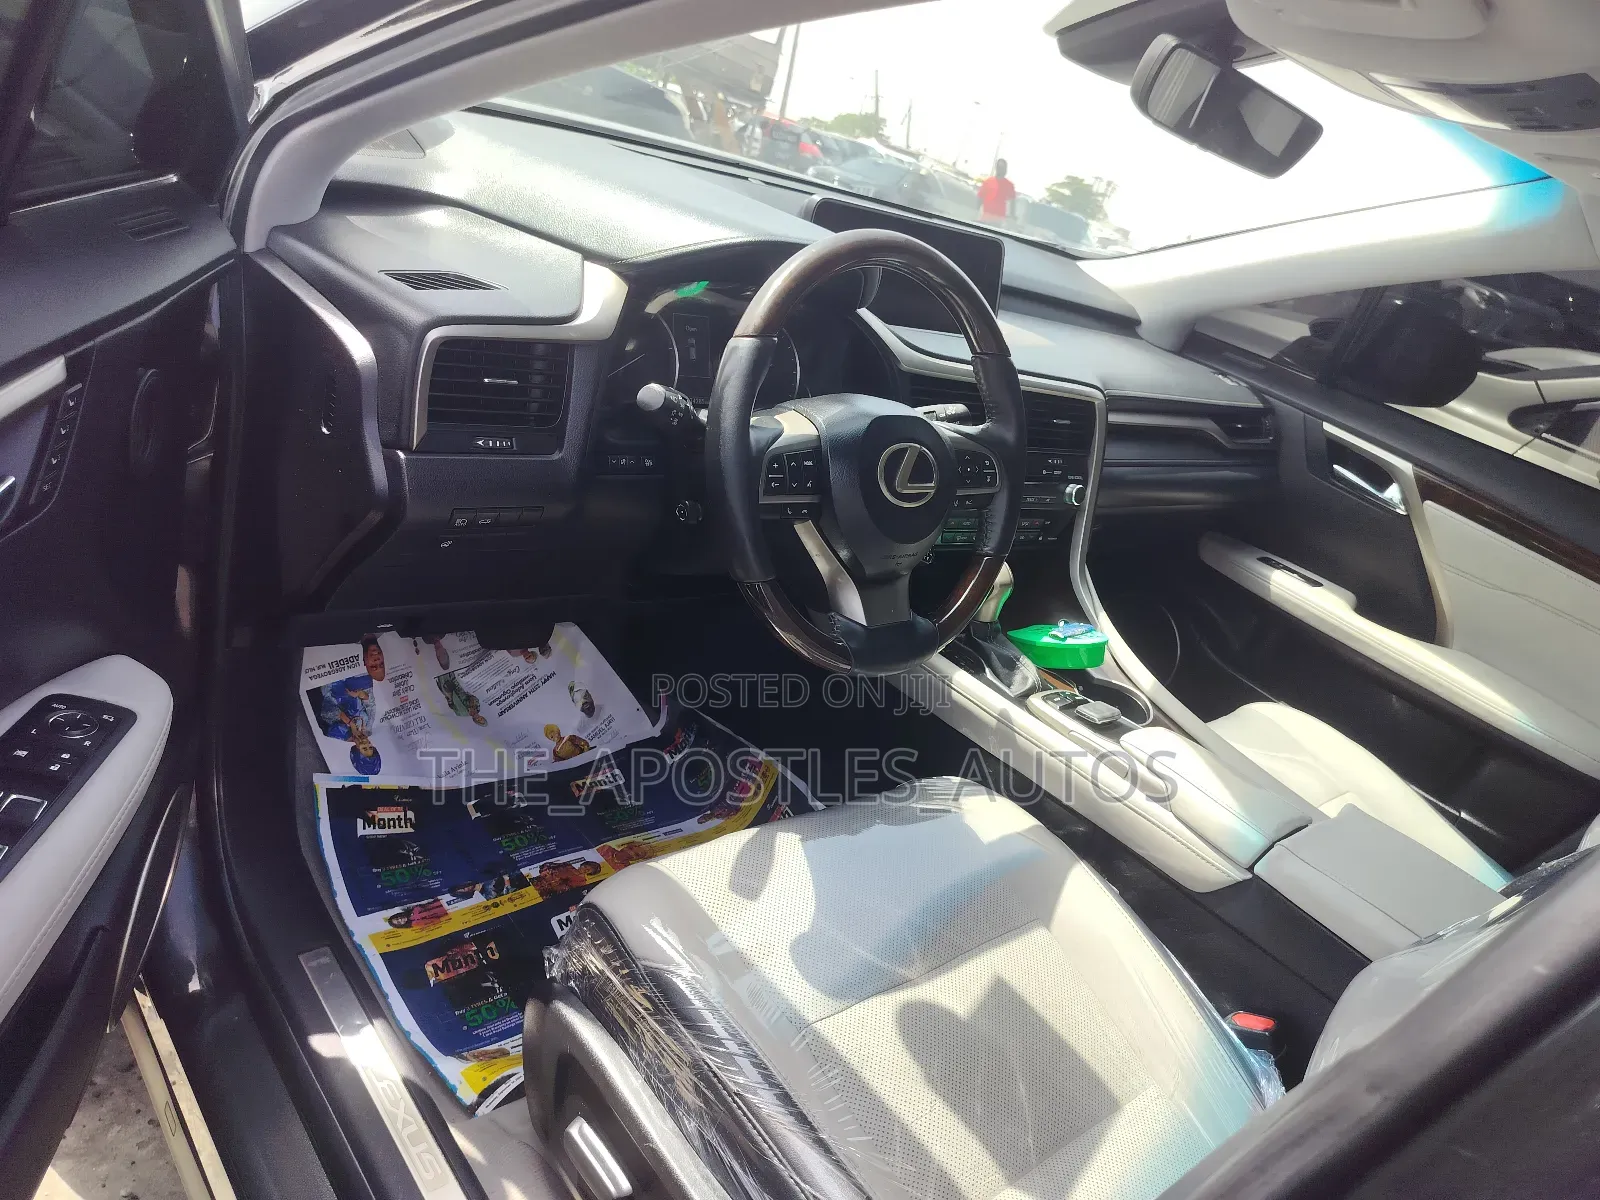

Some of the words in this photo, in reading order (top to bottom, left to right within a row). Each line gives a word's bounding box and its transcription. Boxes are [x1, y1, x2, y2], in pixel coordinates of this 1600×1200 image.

[328, 653, 360, 670] ADEDEJI
[348, 662, 360, 671] LION
[362, 812, 413, 830] Month
[381, 864, 432, 887] 50%
[465, 996, 518, 1027] 50%
